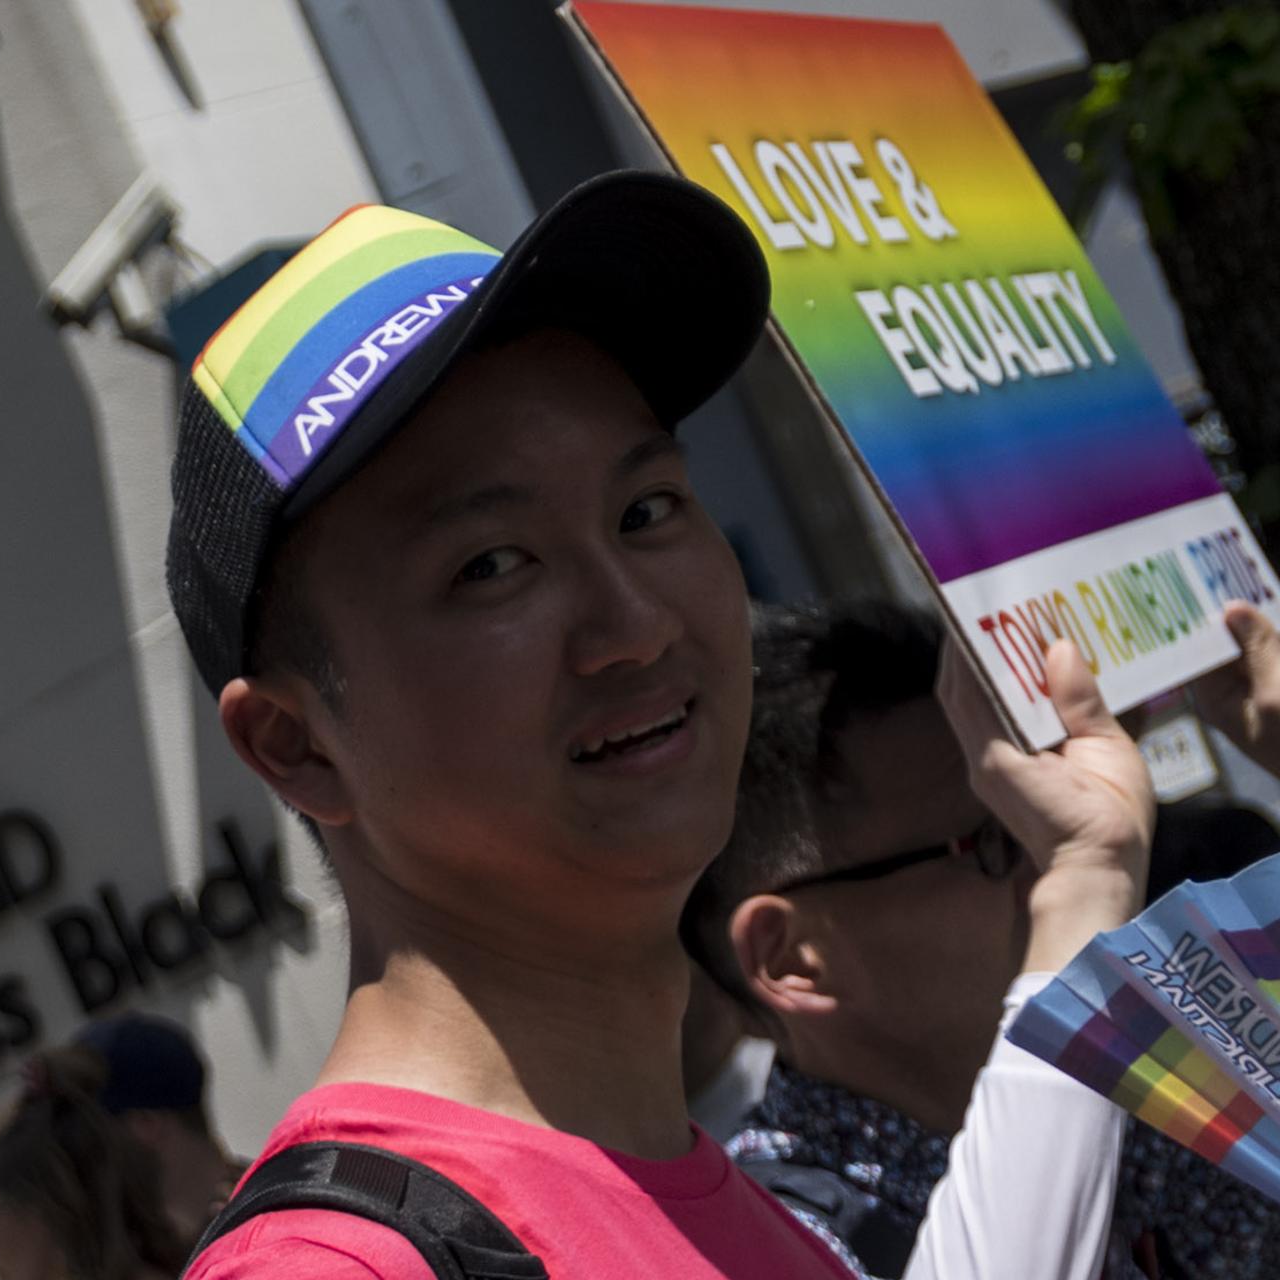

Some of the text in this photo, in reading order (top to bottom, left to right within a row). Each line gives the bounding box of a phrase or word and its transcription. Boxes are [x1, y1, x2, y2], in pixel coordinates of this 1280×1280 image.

[710, 138, 959, 250] LOVE &
[294, 284, 468, 457] ANDREW
[854, 270, 1117, 398] EQUALITY
[1074, 549, 1208, 668] RAINBOW
[1186, 527, 1276, 608] PRIDE
